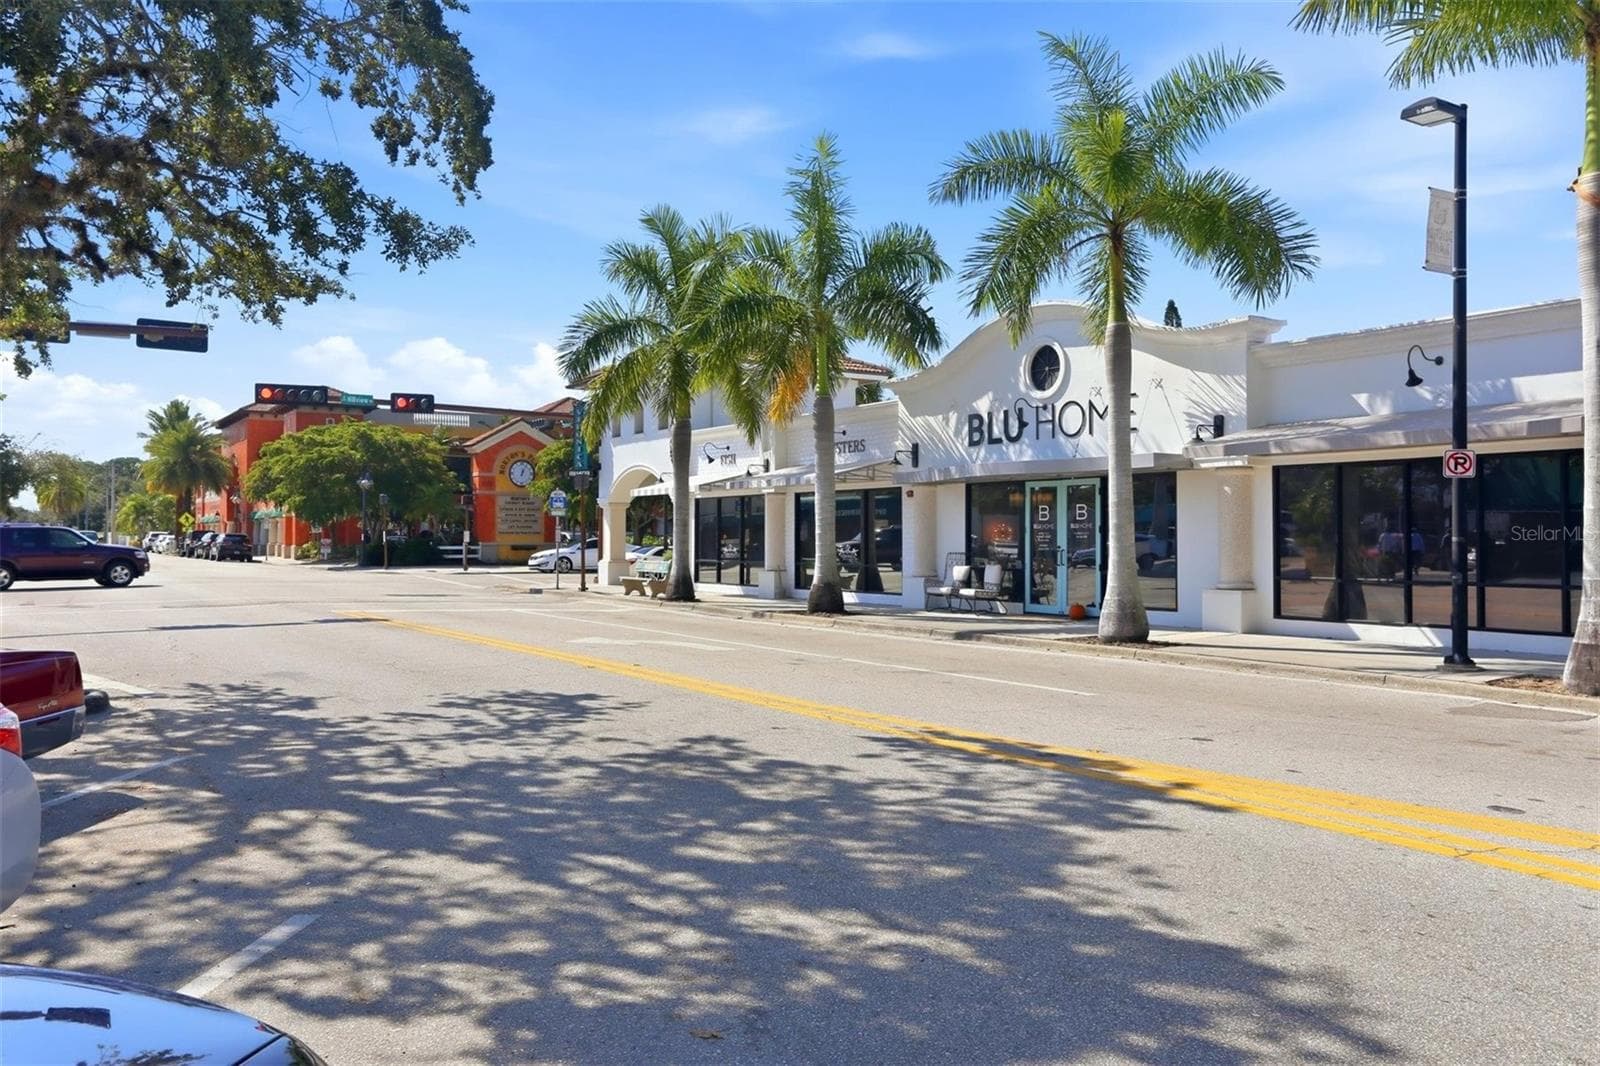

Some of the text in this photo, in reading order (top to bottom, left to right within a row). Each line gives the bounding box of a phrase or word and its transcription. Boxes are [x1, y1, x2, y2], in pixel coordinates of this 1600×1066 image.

[968, 408, 1024, 447] BLU
[833, 439, 866, 455] STERS
[1038, 505, 1050, 521] B
[1075, 504, 1088, 520] B
